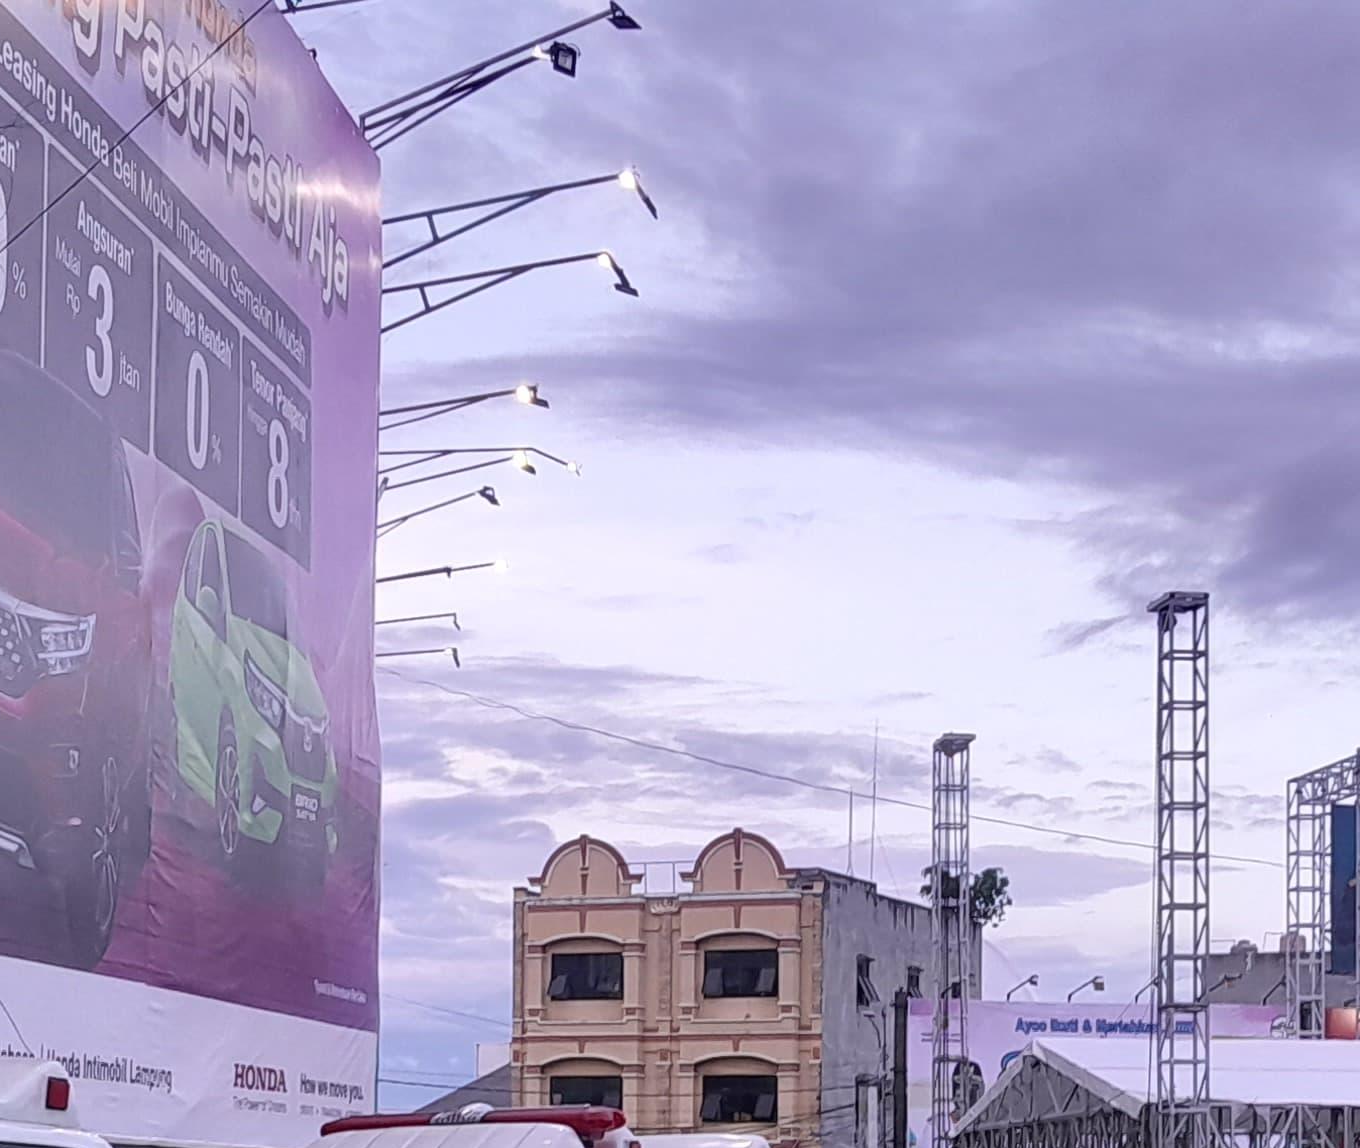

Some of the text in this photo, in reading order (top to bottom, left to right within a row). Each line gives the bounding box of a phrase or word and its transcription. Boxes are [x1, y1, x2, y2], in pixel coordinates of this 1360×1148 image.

[60, 87, 111, 163] Honda
[112, 145, 138, 196] Beli
[140, 168, 175, 232] Mobil
[175, 206, 231, 290] Impianmu
[11, 261, 27, 300] %
[307, 198, 349, 305] Aja
[65, 282, 81, 319] Rp
[165, 280, 197, 338] Bunga
[85, 264, 114, 398] 3
[186, 350, 210, 470] 0
[267, 418, 289, 529] 8
[82, 1052, 128, 1085] Intimobil
[129, 1057, 173, 1094] Lampung
[232, 1062, 288, 1094] HONDA
[299, 1072, 317, 1095] How
